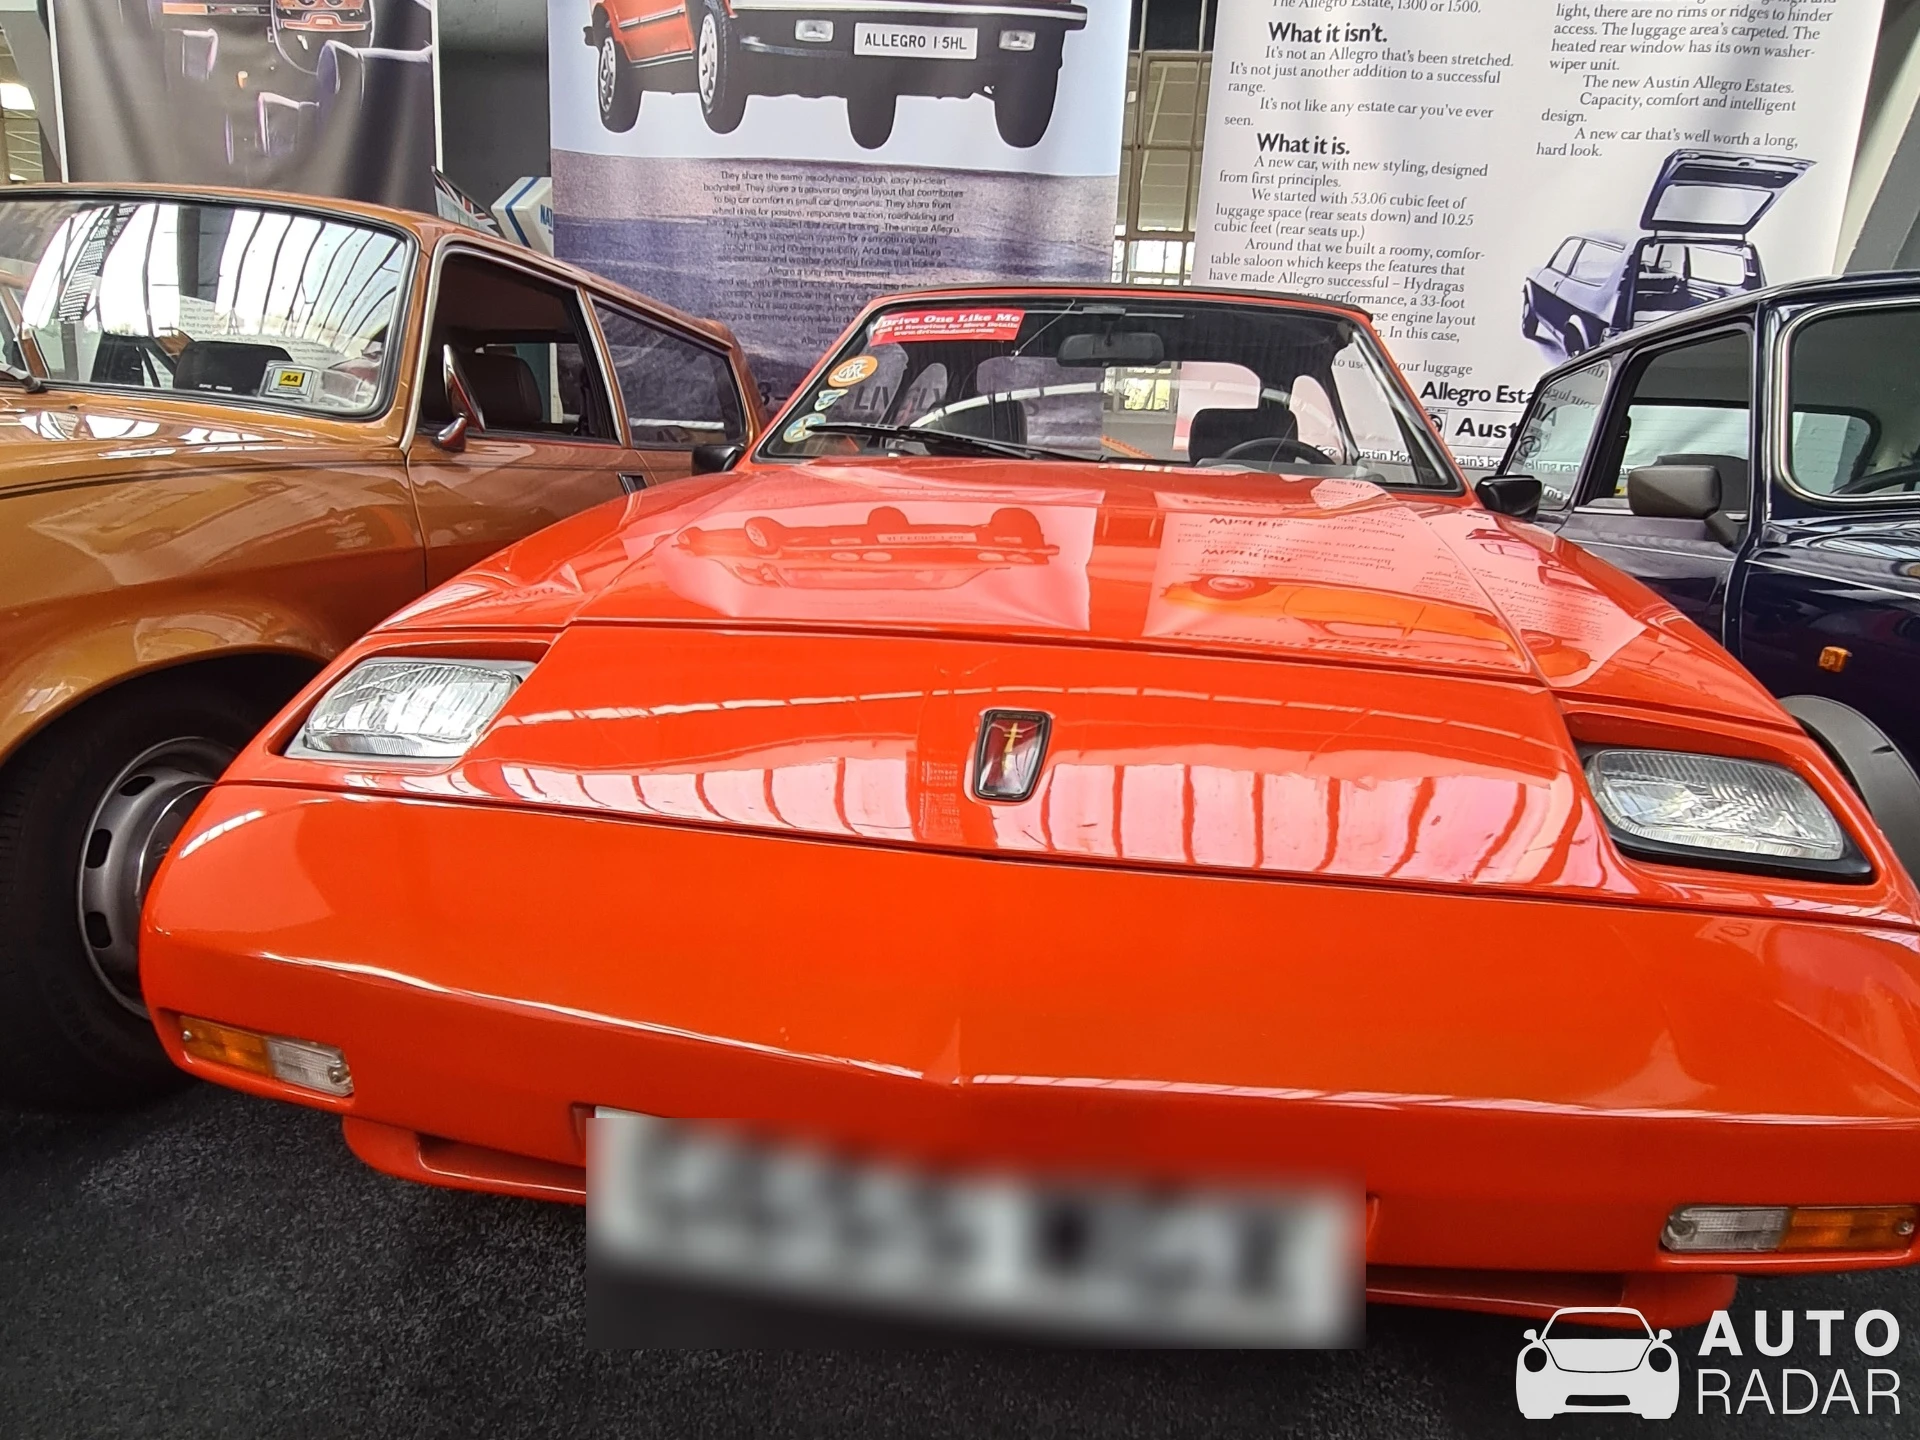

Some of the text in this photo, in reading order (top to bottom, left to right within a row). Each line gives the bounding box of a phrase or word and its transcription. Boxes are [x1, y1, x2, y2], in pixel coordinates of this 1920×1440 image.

[1298, 0, 1347, 12] Allegro
[1351, 0, 1394, 11] Estate,
[1398, 0, 1428, 11] 1300
[1430, 3, 1445, 12] or
[1448, 0, 1481, 13] 1500.
[1556, 3, 1833, 23] light, there are no rims or ridges to hinder
[864, 33, 926, 49] ALLEGRO
[1268, 21, 1388, 44] What it isn't.
[1554, 22, 1820, 42] access. The luggage area's carpeted. The
[1265, 45, 1514, 67] It's not an Allegro that's been stretched.
[1551, 38, 1597, 53] heated
[1599, 44, 1627, 53] rear
[1630, 40, 1685, 53] window
[1688, 39, 1712, 53] has
[1715, 40, 1731, 53] its
[1733, 45, 1760, 56] own
[1549, 57, 1620, 74] wiper unit.
[1582, 74, 1794, 94] The new Austin Allegro Estates.
[1260, 97, 1494, 120] It's not like any estate car you've ever
[1580, 92, 1796, 116] Capacity, comfort and intelligent
[1224, 116, 1254, 126] seen.
[1541, 108, 1587, 126] design.
[1257, 132, 1350, 155] What it is.
[1536, 142, 1602, 156] hard look.
[1574, 127, 1798, 151] A new car that's well worth a long,
[1254, 155, 1488, 180] A new car, with new styling, designed
[1219, 169, 1341, 189] from first principles.
[1252, 187, 1467, 209] We started with 53.06 cubic feet of
[1214, 221, 1247, 233] cubic
[1250, 220, 1272, 234] feet
[1276, 221, 1305, 237] (rear
[1308, 227, 1337, 237] seats
[1244, 237, 1294, 251] Around
[1297, 239, 1321, 252] that
[1325, 244, 1342, 254] we
[1345, 240, 1375, 255] built
[1378, 246, 1386, 255] a
[1389, 247, 1433, 262] roomy,
[1209, 268, 1464, 295] have made Allegro successful Hydragas
[1410, 297, 1417, 306] a
[1420, 294, 1465, 309] 33-foot
[881, 313, 1020, 327] Drive One Like Me
[1391, 313, 1433, 327] engine
[1436, 311, 1476, 329] layout
[1389, 325, 1402, 338] In
[1406, 326, 1428, 339] this
[1431, 332, 1460, 343] case,
[282, 374, 299, 382] AA
[1423, 360, 1473, 378] luggage
[1420, 381, 1536, 407] Allegro Esta
[1455, 417, 1518, 439] Aust
[1358, 450, 1388, 461] ustin
